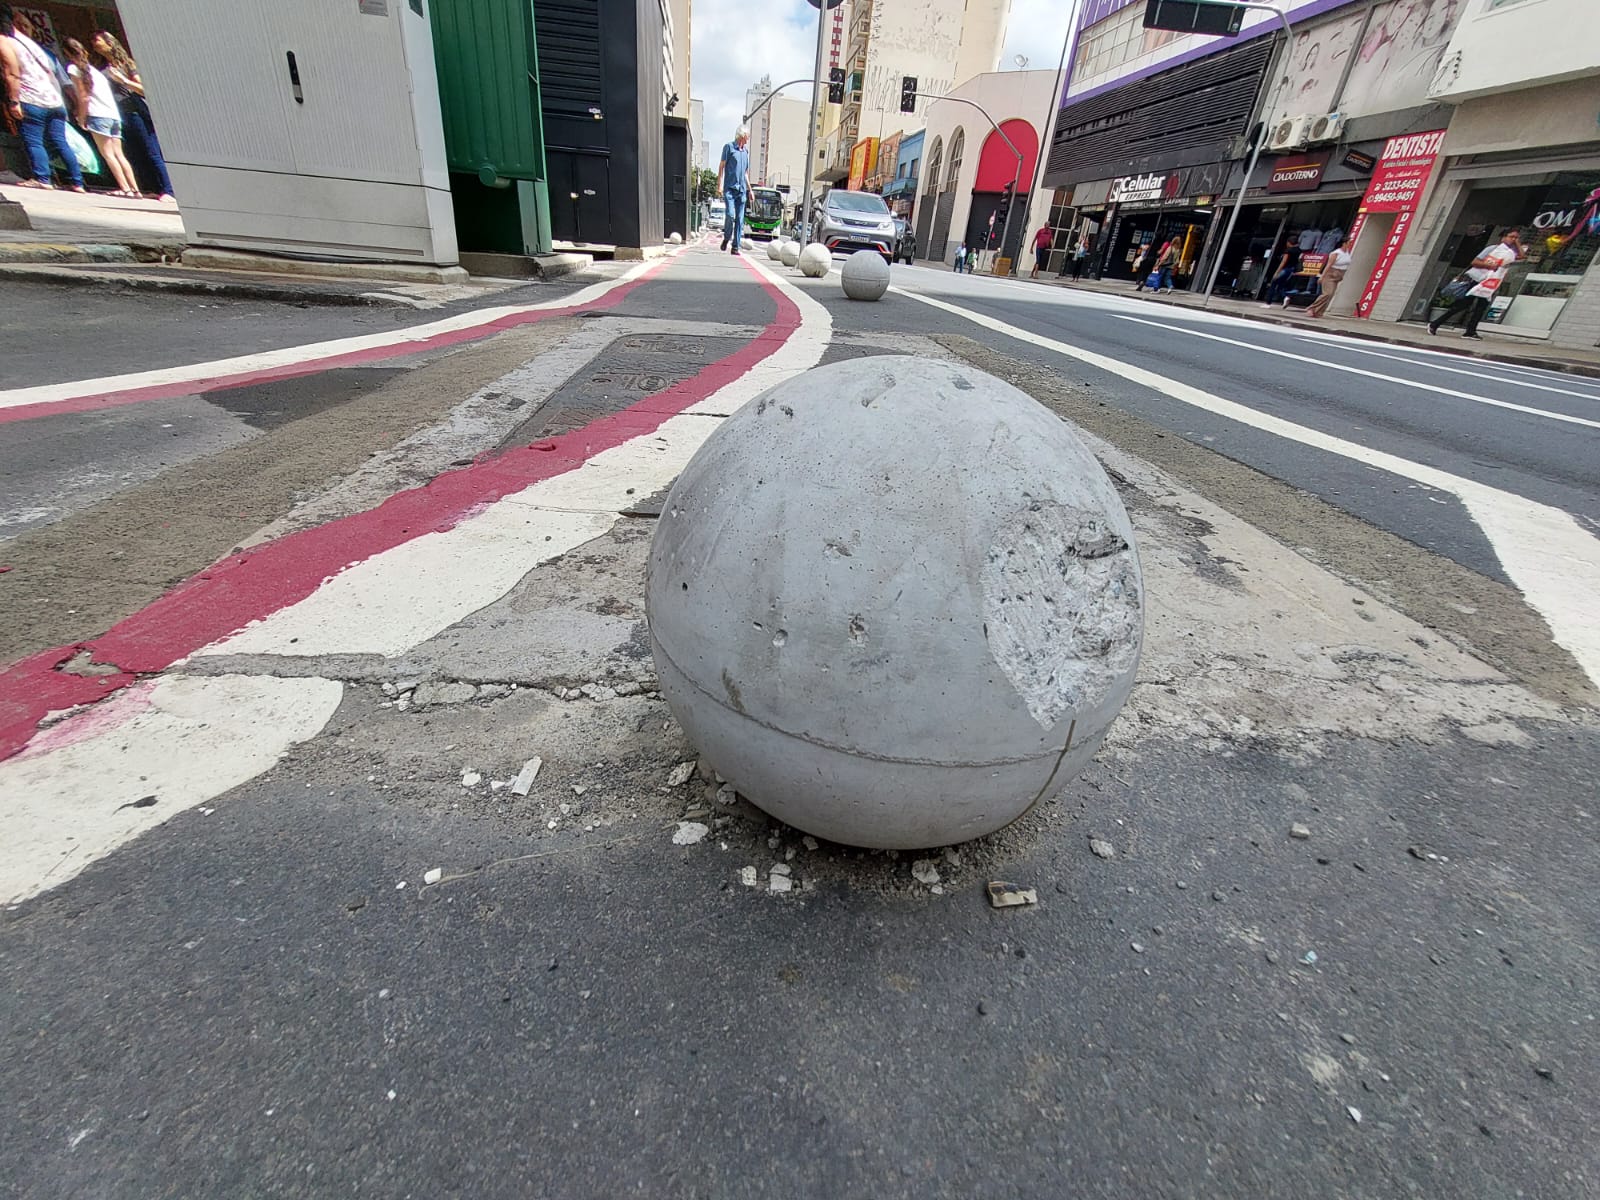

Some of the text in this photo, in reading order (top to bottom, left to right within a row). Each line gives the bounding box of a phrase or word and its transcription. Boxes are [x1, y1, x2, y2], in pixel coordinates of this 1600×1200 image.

[1381, 132, 1446, 160] DENTISTA
[1120, 173, 1166, 192] Celular
[1125, 191, 1153, 200] EXPRESS
[1533, 209, 1576, 228] OM
[1361, 213, 1410, 311] DENTISTAS
